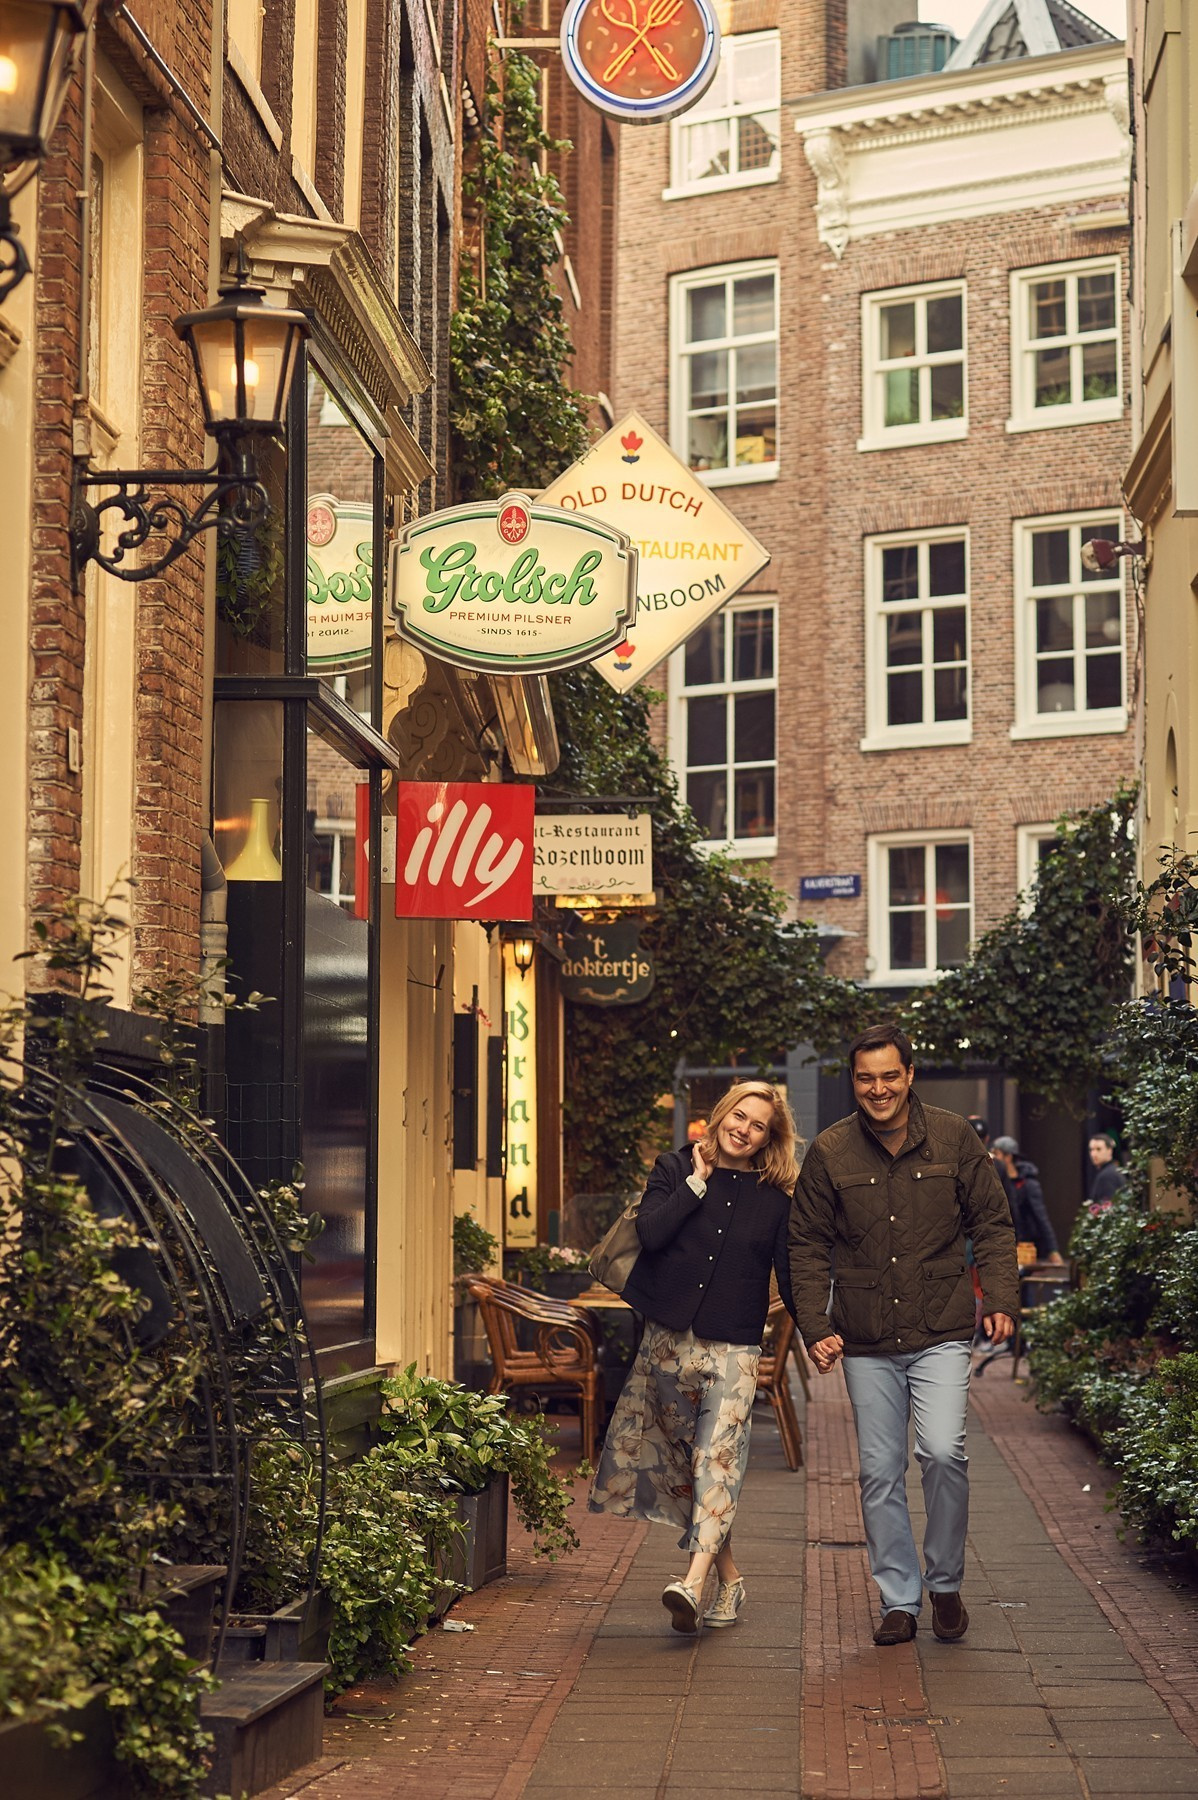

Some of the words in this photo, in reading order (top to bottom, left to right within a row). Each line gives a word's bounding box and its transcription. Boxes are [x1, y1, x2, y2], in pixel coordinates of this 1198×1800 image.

[560, 485, 607, 510] OLD
[621, 483, 703, 517] DUTCH
[630, 540, 743, 562] TAURANT
[419, 541, 603, 614] Grolsch
[636, 573, 726, 612] NBOOM
[449, 611, 510, 622] PREMIUM
[514, 614, 572, 625] PILSNER
[404, 799, 524, 907] illy
[509, 1000, 532, 1219] Brand
